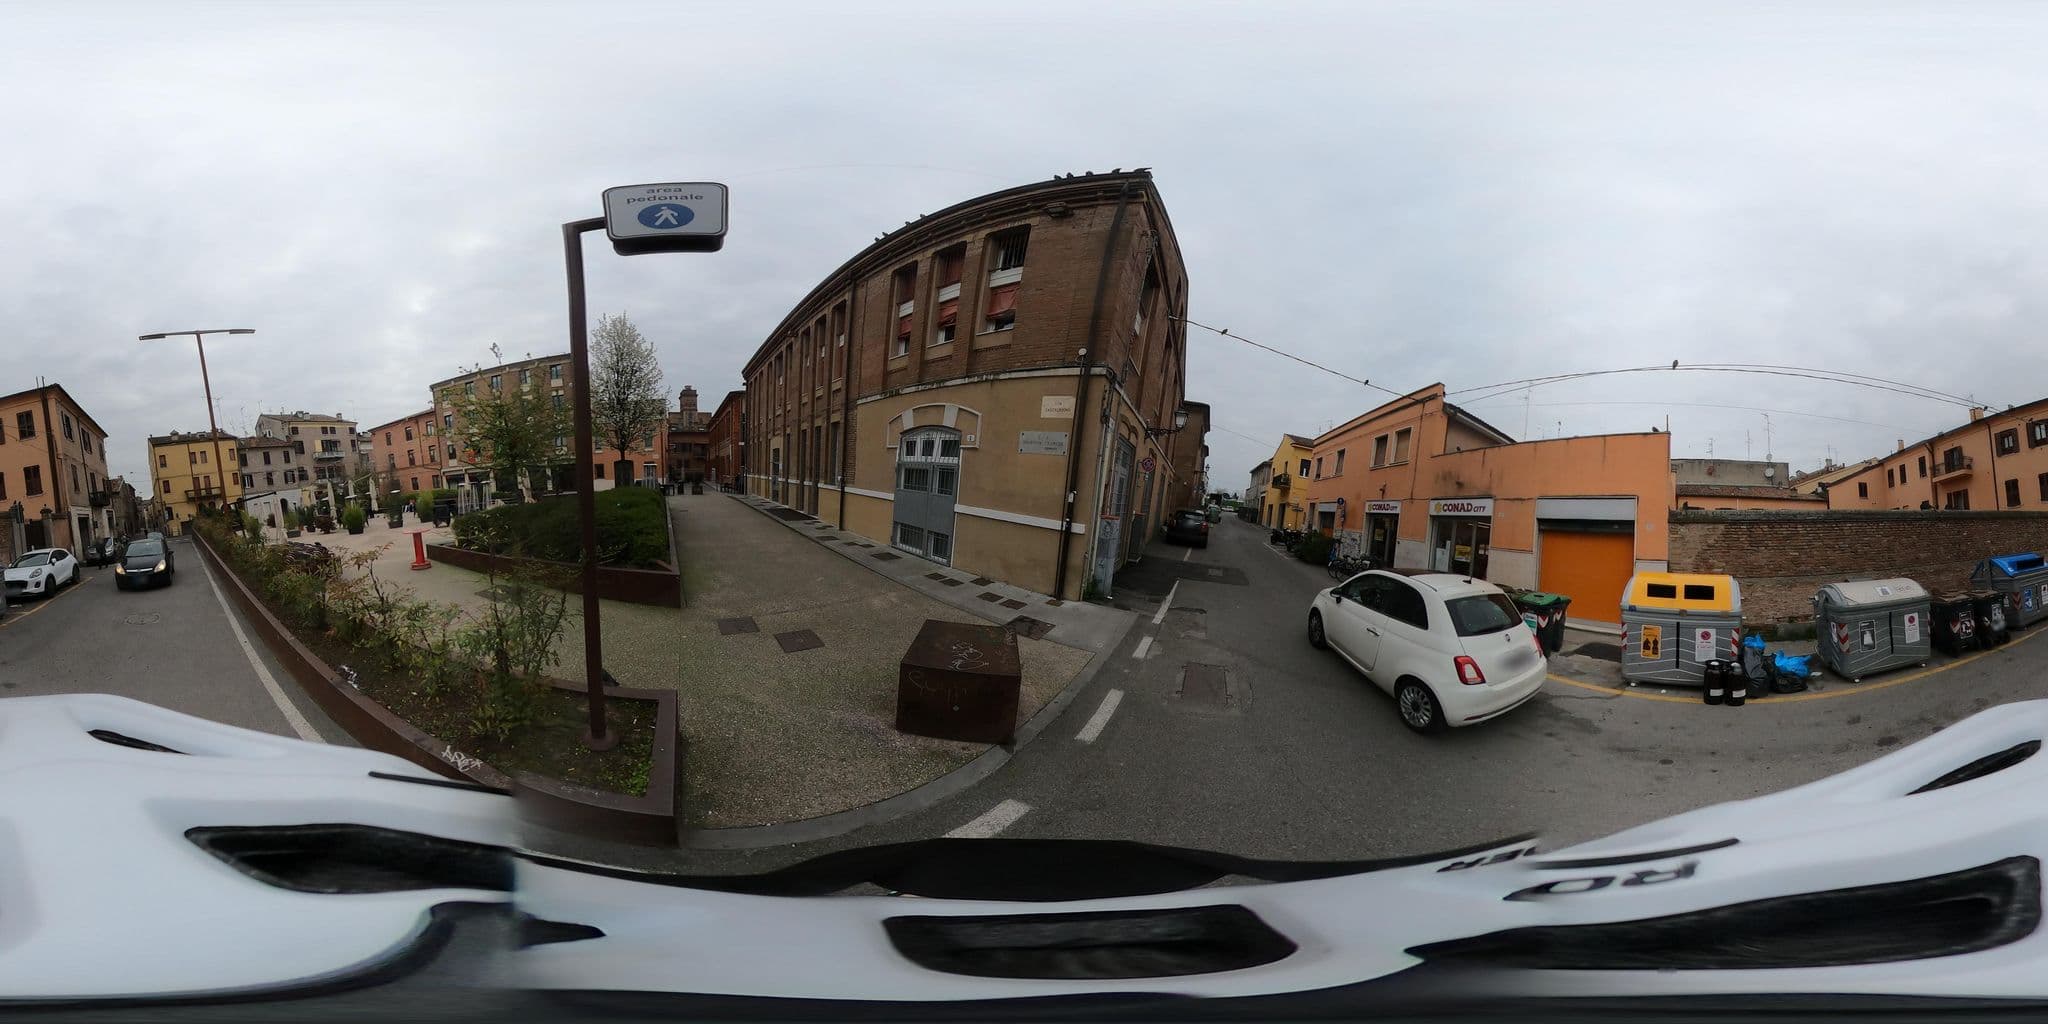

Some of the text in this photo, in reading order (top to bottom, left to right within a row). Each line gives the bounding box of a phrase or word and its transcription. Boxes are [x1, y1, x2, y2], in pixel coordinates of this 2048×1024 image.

[626, 193, 704, 204] pedonale
[1372, 503, 1390, 511] CONAD
[1442, 502, 1486, 513] CONAD CITY
